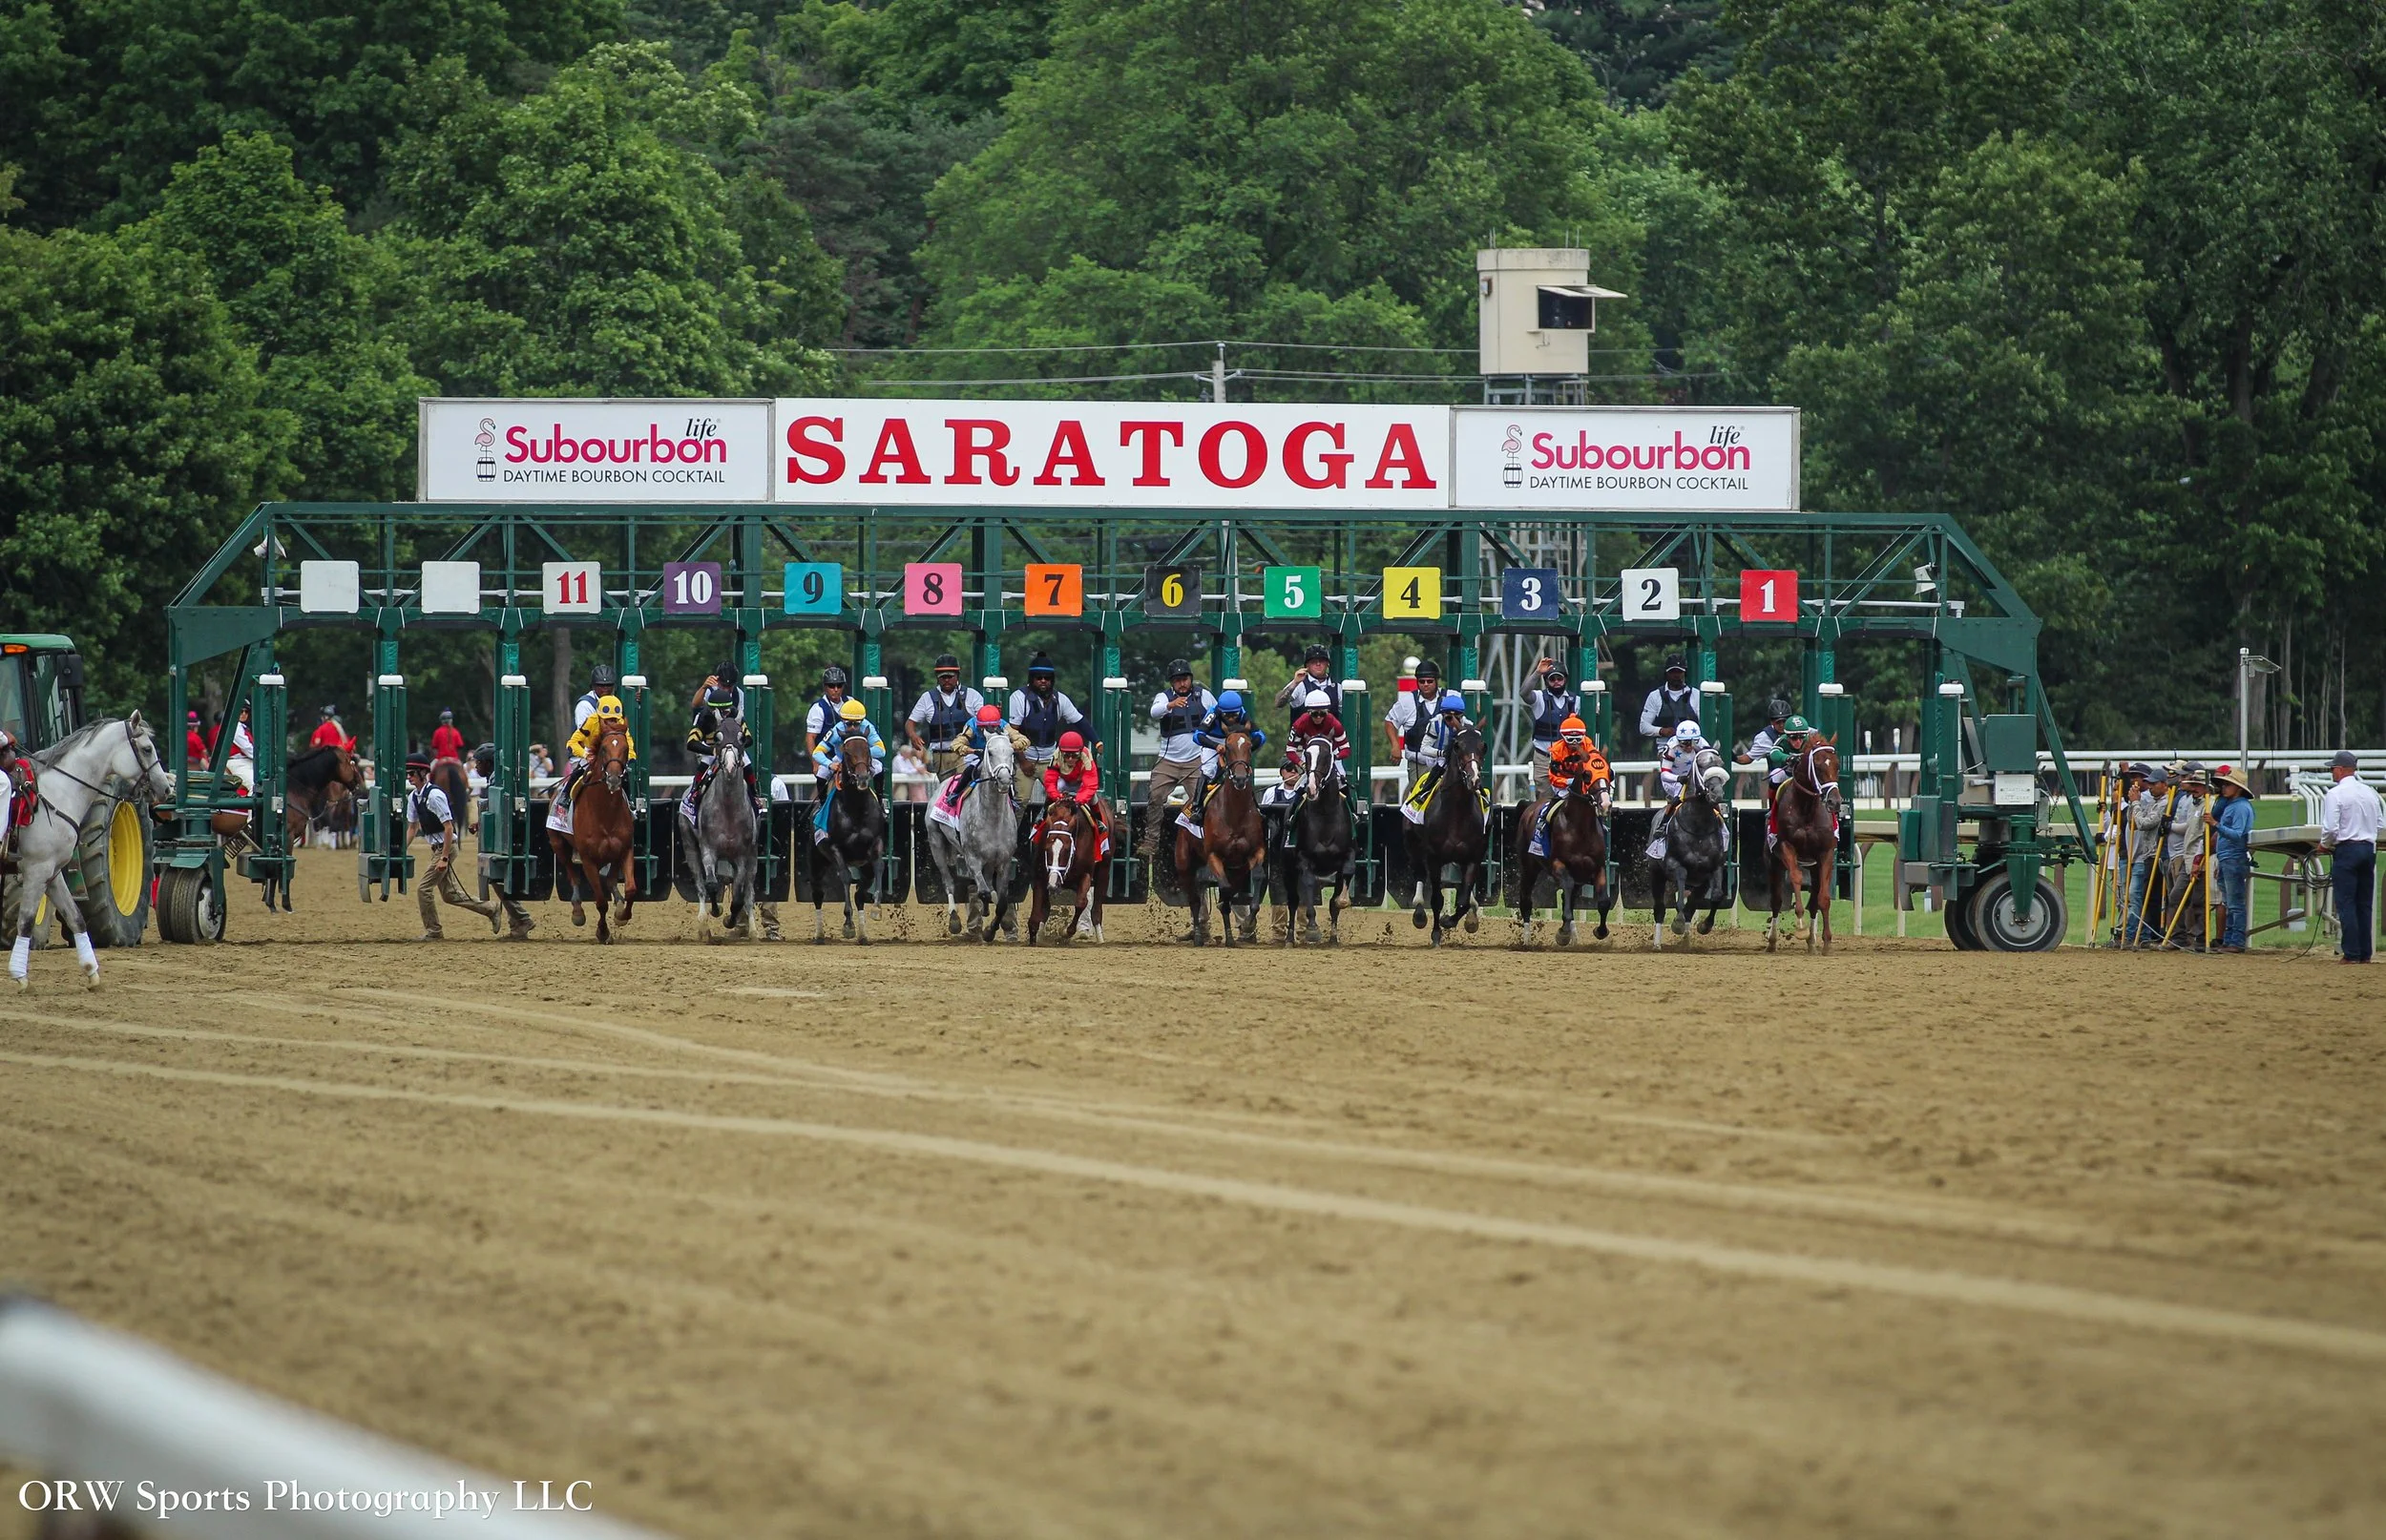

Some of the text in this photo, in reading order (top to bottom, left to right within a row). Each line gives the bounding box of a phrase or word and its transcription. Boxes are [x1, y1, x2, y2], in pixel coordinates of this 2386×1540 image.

[505, 424, 727, 465] Subourbon
[685, 418, 718, 442] life
[1709, 425, 1741, 449] life
[787, 416, 1437, 489] SARATOGA
[1531, 429, 1751, 471] Subourbon
[503, 469, 725, 483] DAYTIME BOURBON COCKTAIL
[1530, 476, 1748, 490] DAYTIME BOURBON COCKTAIL
[558, 572, 588, 604] 11
[673, 570, 713, 605] 10
[803, 571, 825, 605] 9
[922, 572, 944, 606] 8
[1043, 573, 1065, 606] 7
[1162, 573, 1184, 608] 6
[1284, 574, 1305, 609] 5
[1400, 576, 1422, 609] 4
[1520, 576, 1542, 612] 3
[1641, 578, 1662, 612] 2
[1760, 579, 1776, 613] 1
[823, 730, 832, 741] 9
